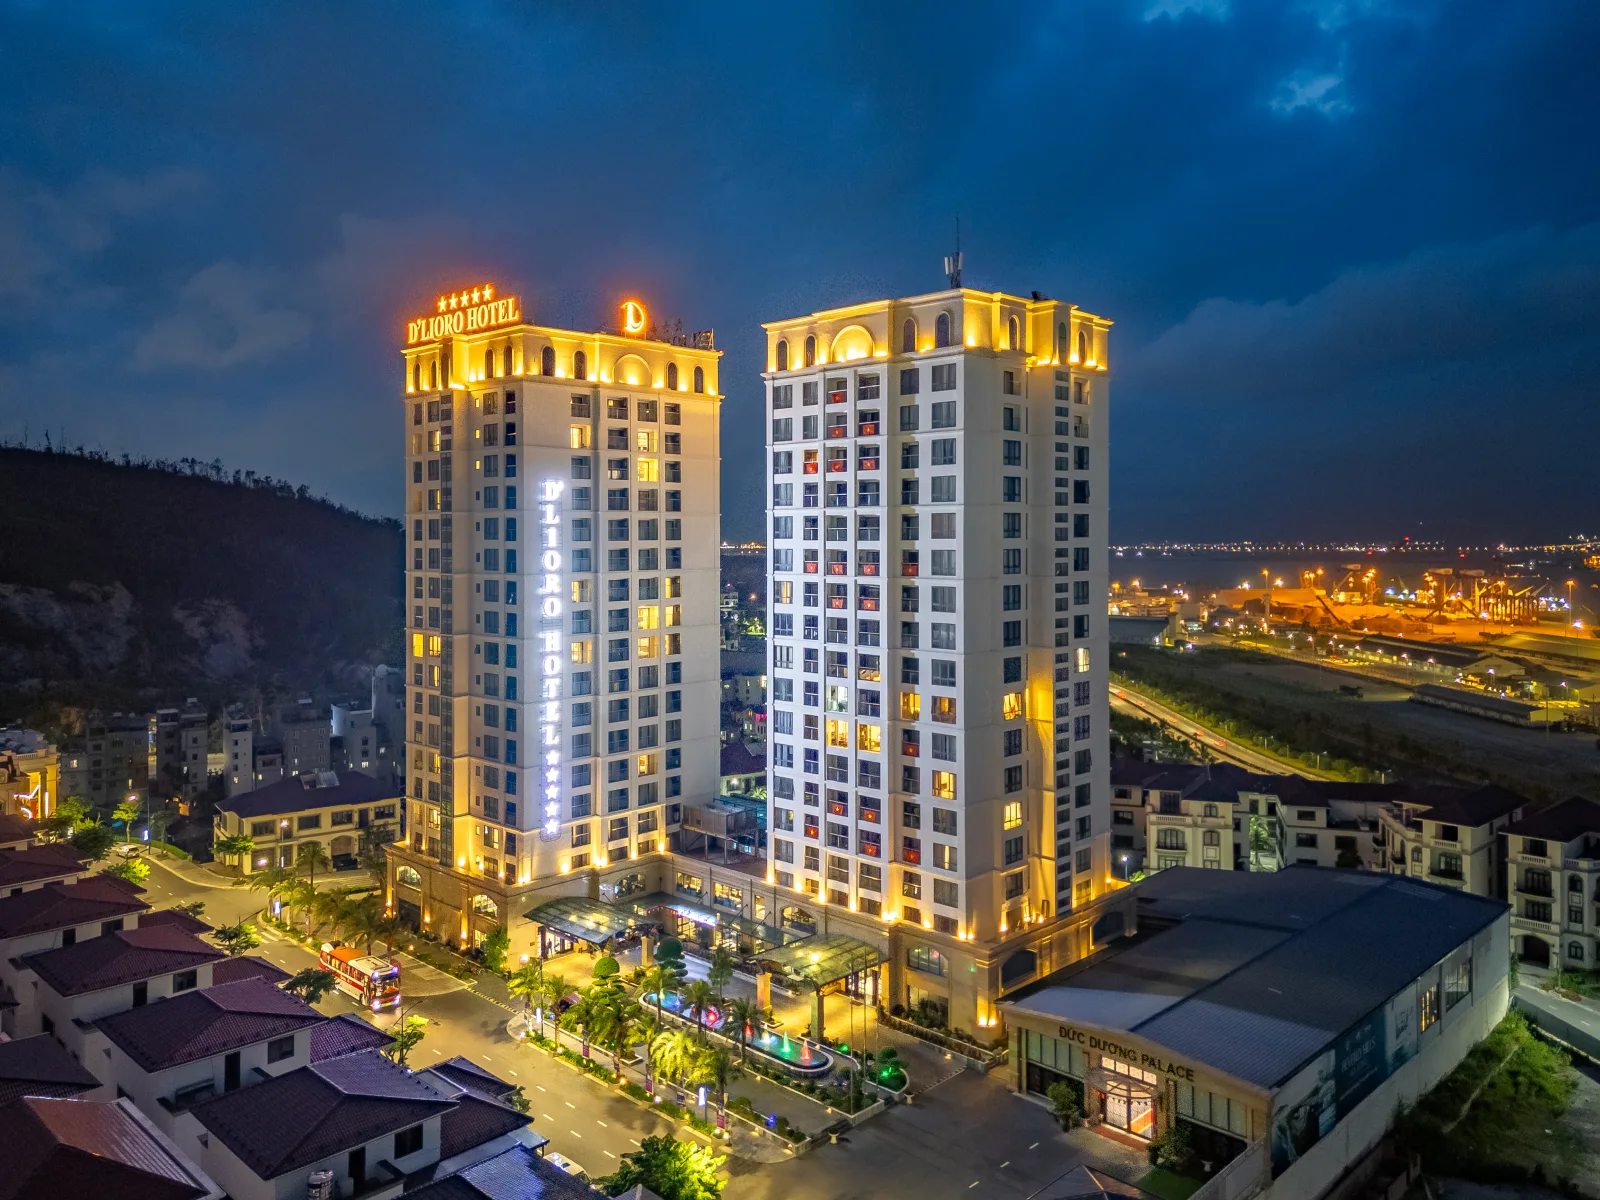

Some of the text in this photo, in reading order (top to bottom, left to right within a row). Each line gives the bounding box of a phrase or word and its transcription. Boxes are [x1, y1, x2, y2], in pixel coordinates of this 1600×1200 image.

[408, 298, 519, 344] D'LIORO HOTEL
[542, 632, 561, 745] HOTEL
[1089, 1036, 1137, 1061] DƯƠNG
[1141, 1053, 1194, 1081] PALACE
